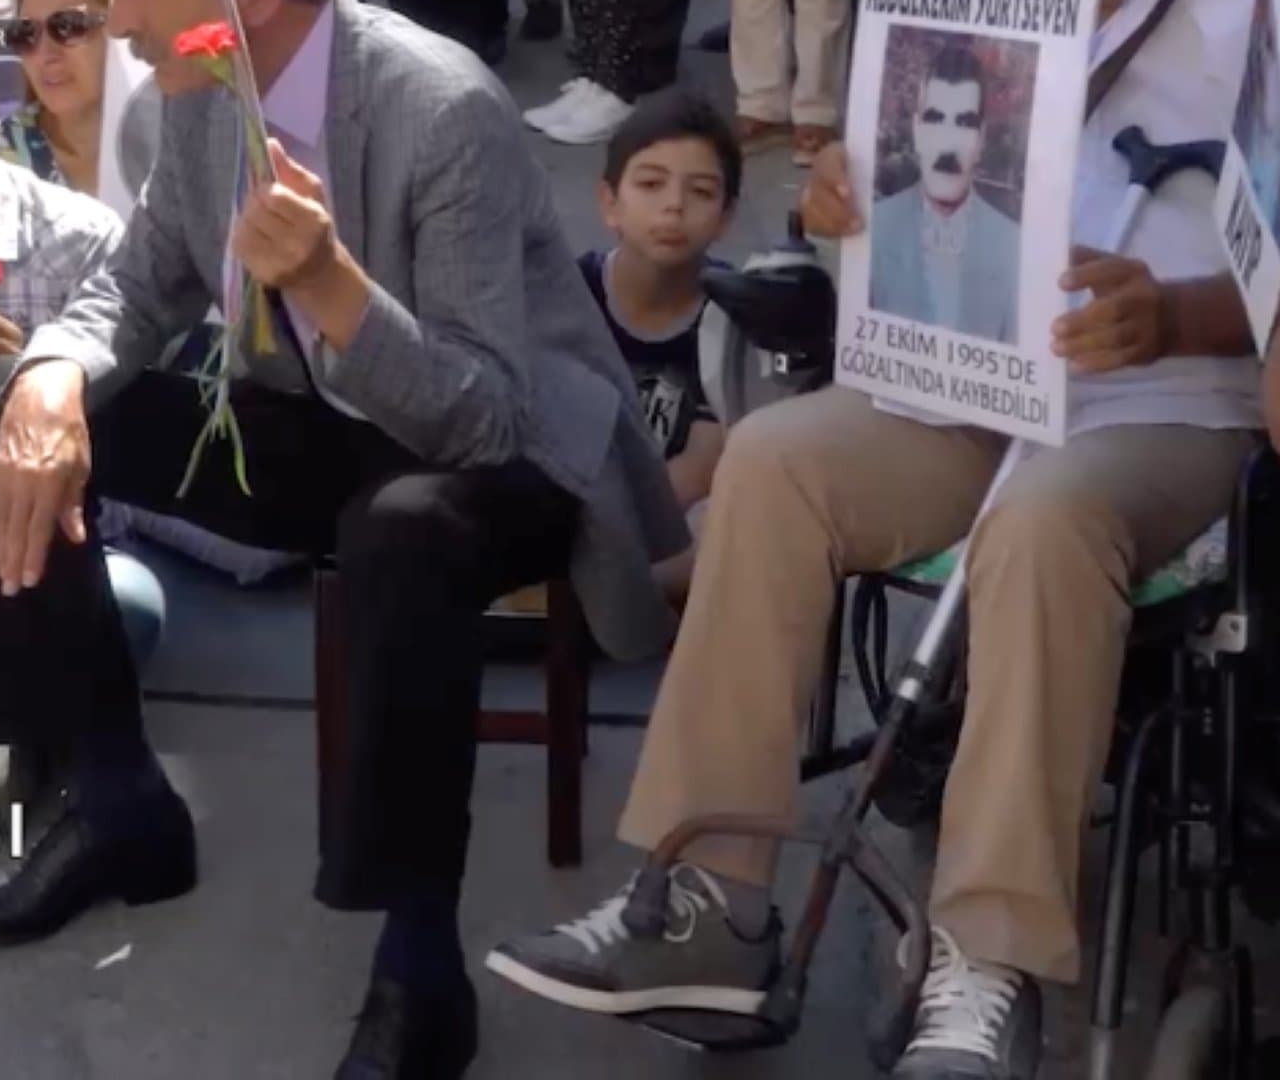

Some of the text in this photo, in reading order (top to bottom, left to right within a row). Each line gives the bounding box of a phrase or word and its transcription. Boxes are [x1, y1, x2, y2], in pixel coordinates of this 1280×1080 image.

[854, 314, 882, 344] 27
[885, 320, 939, 363] EKİM
[840, 342, 1050, 428] GÖZALTINDA KAYBEDİLDİ
